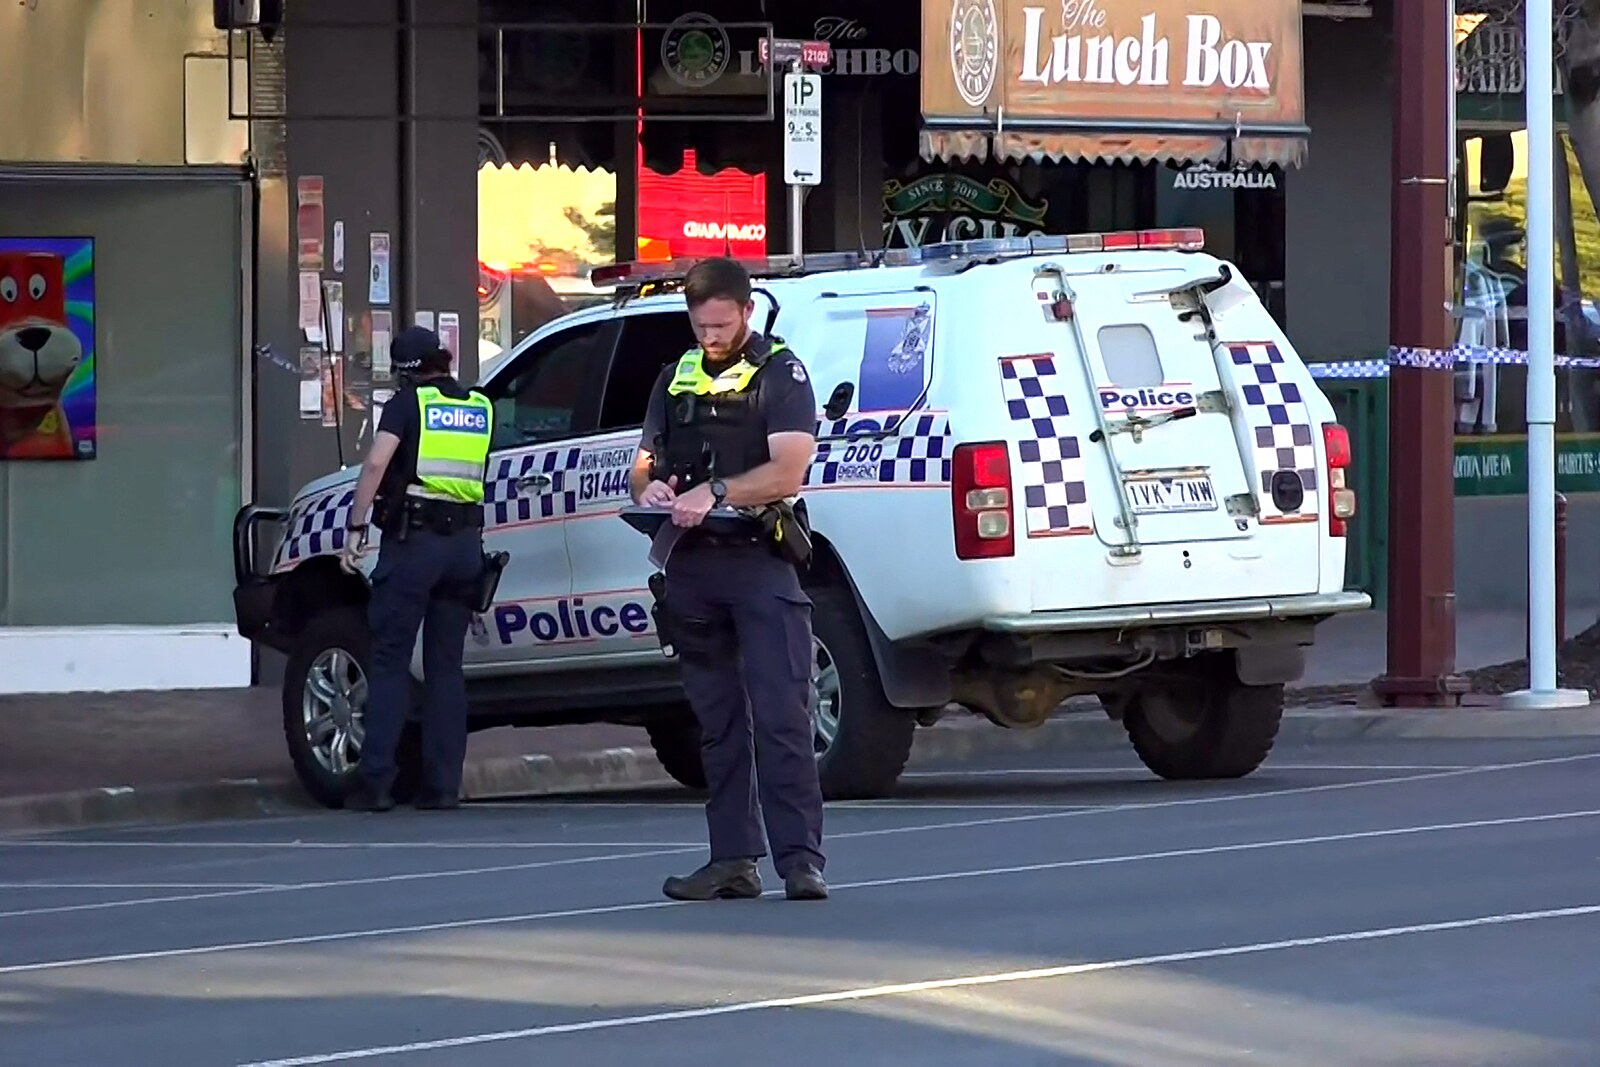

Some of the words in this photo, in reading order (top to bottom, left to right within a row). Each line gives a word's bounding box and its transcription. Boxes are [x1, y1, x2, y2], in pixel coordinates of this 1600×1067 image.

[1062, 0, 1107, 30] The
[814, 16, 868, 41] The
[1018, 6, 1169, 87] Lunch
[1182, 14, 1272, 93] Box
[791, 76, 814, 107] 1P
[908, 179, 944, 201] SINCE
[951, 180, 979, 201] 2019
[1173, 172, 1277, 189] AUSTRALIA
[1100, 388, 1193, 408] Police
[428, 408, 486, 429] Police
[580, 448, 634, 470] NON-URGENT
[843, 444, 883, 462] 000
[1130, 484, 1164, 506] 1VK
[1175, 481, 1213, 503] 7NW
[494, 598, 649, 645] Police
